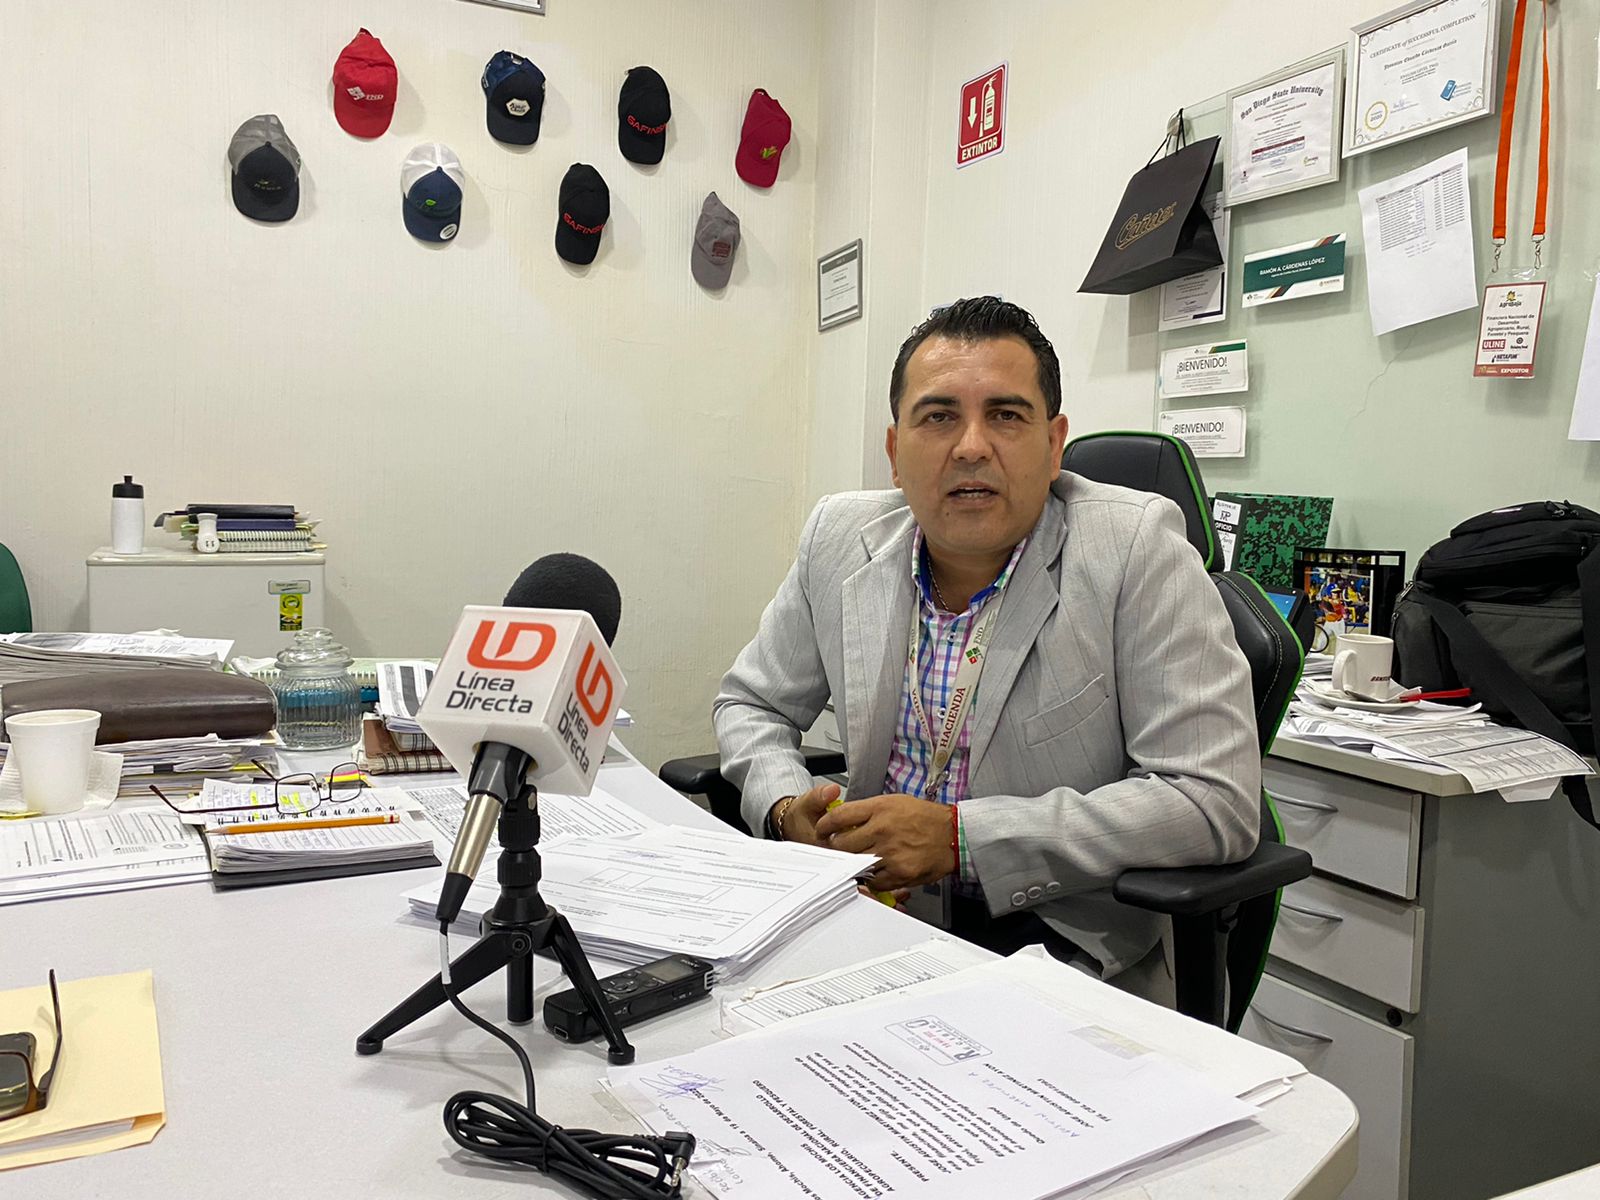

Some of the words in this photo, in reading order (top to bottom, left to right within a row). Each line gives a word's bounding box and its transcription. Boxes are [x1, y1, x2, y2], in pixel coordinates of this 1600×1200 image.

[1369, 42, 1401, 59] CERTIFICATE
[1408, 28, 1440, 46] SUCCESSFUL
[1440, 13, 1477, 32] COMPLETION
[1271, 89, 1289, 100] State
[1290, 86, 1324, 96] University
[962, 136, 998, 161] EXTINTOR
[1259, 266, 1277, 276] RAMÓN
[1282, 260, 1308, 271] CÁRDENAS
[1308, 256, 1326, 266] LÓPEZ
[1483, 340, 1505, 349] ULINE
[1176, 356, 1228, 374] ¡BIENVENIDO!
[456, 670, 515, 691] Línea
[446, 690, 533, 714] Directa
[565, 692, 589, 740] Línea
[940, 686, 967, 748] HACIENDA
[557, 712, 590, 775] Directa
[982, 1063, 1004, 1074] AYON
[753, 1080, 783, 1103] PESQUERO
[1002, 1075, 1040, 1094] MARTINEZ
[709, 1104, 724, 1117] Mayo
[756, 1095, 794, 1124] DESARROLLO
[1037, 1095, 1073, 1115] AGUSTIN
[786, 1107, 817, 1130] FORESTAL
[865, 1111, 901, 1135] MARTINEZ
[1070, 1116, 1094, 1128] JOSE
[744, 1134, 766, 1152] Sinaloa
[800, 1130, 833, 1155] NACIONAL
[817, 1129, 839, 1147] RURAL,
[898, 1135, 932, 1158] AGUSTIN
[764, 1152, 789, 1172] Ahome,
[800, 1143, 828, 1163] MOCHIS
[825, 1163, 841, 1174] LOS
[831, 1154, 873, 1187] FINANCIERA
[840, 1148, 895, 1191] AGROPECUARIO,
[890, 1151, 930, 1182] PRESENTE.
[928, 1159, 951, 1174] JOSE
[789, 1172, 813, 1194] Mochis,
[839, 1174, 876, 1199] AGENCIA
